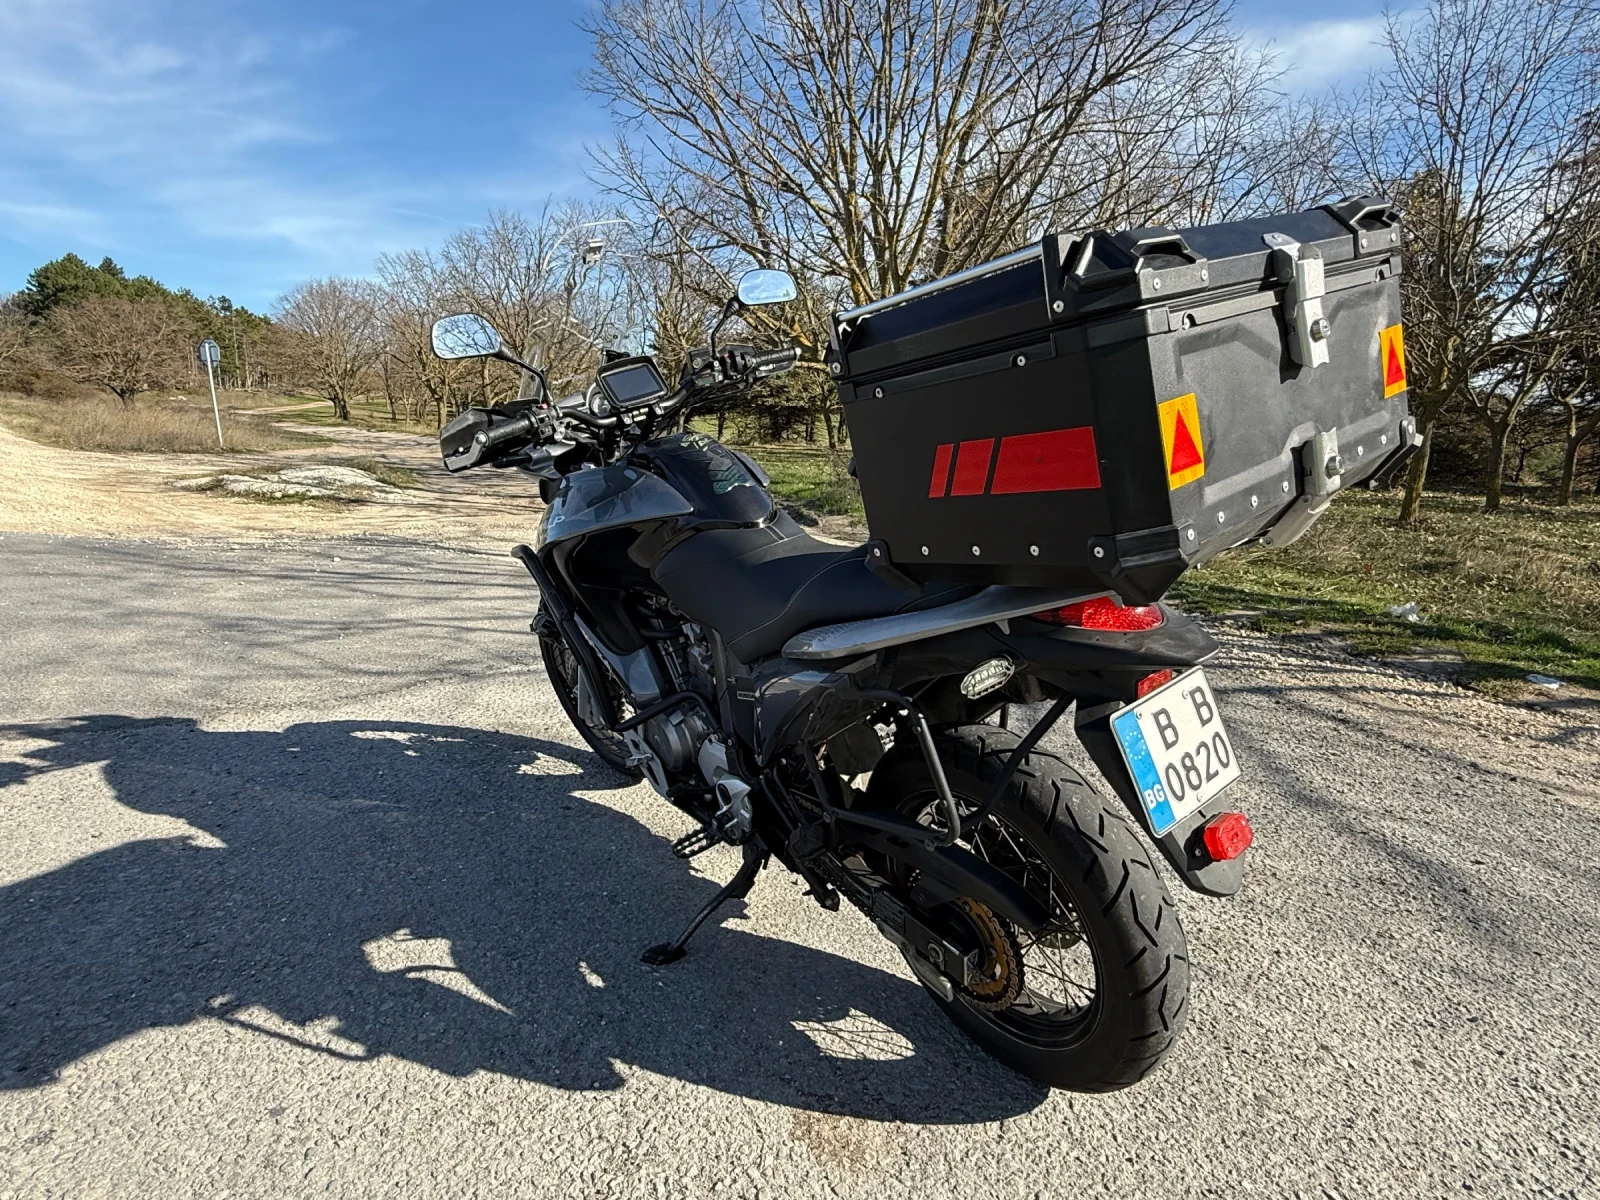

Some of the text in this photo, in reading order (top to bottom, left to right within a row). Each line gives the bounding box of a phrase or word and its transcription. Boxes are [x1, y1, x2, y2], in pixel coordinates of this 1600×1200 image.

[1153, 686, 1214, 750] B B
[1145, 783, 1165, 809] BG
[1165, 731, 1230, 802] 0820
